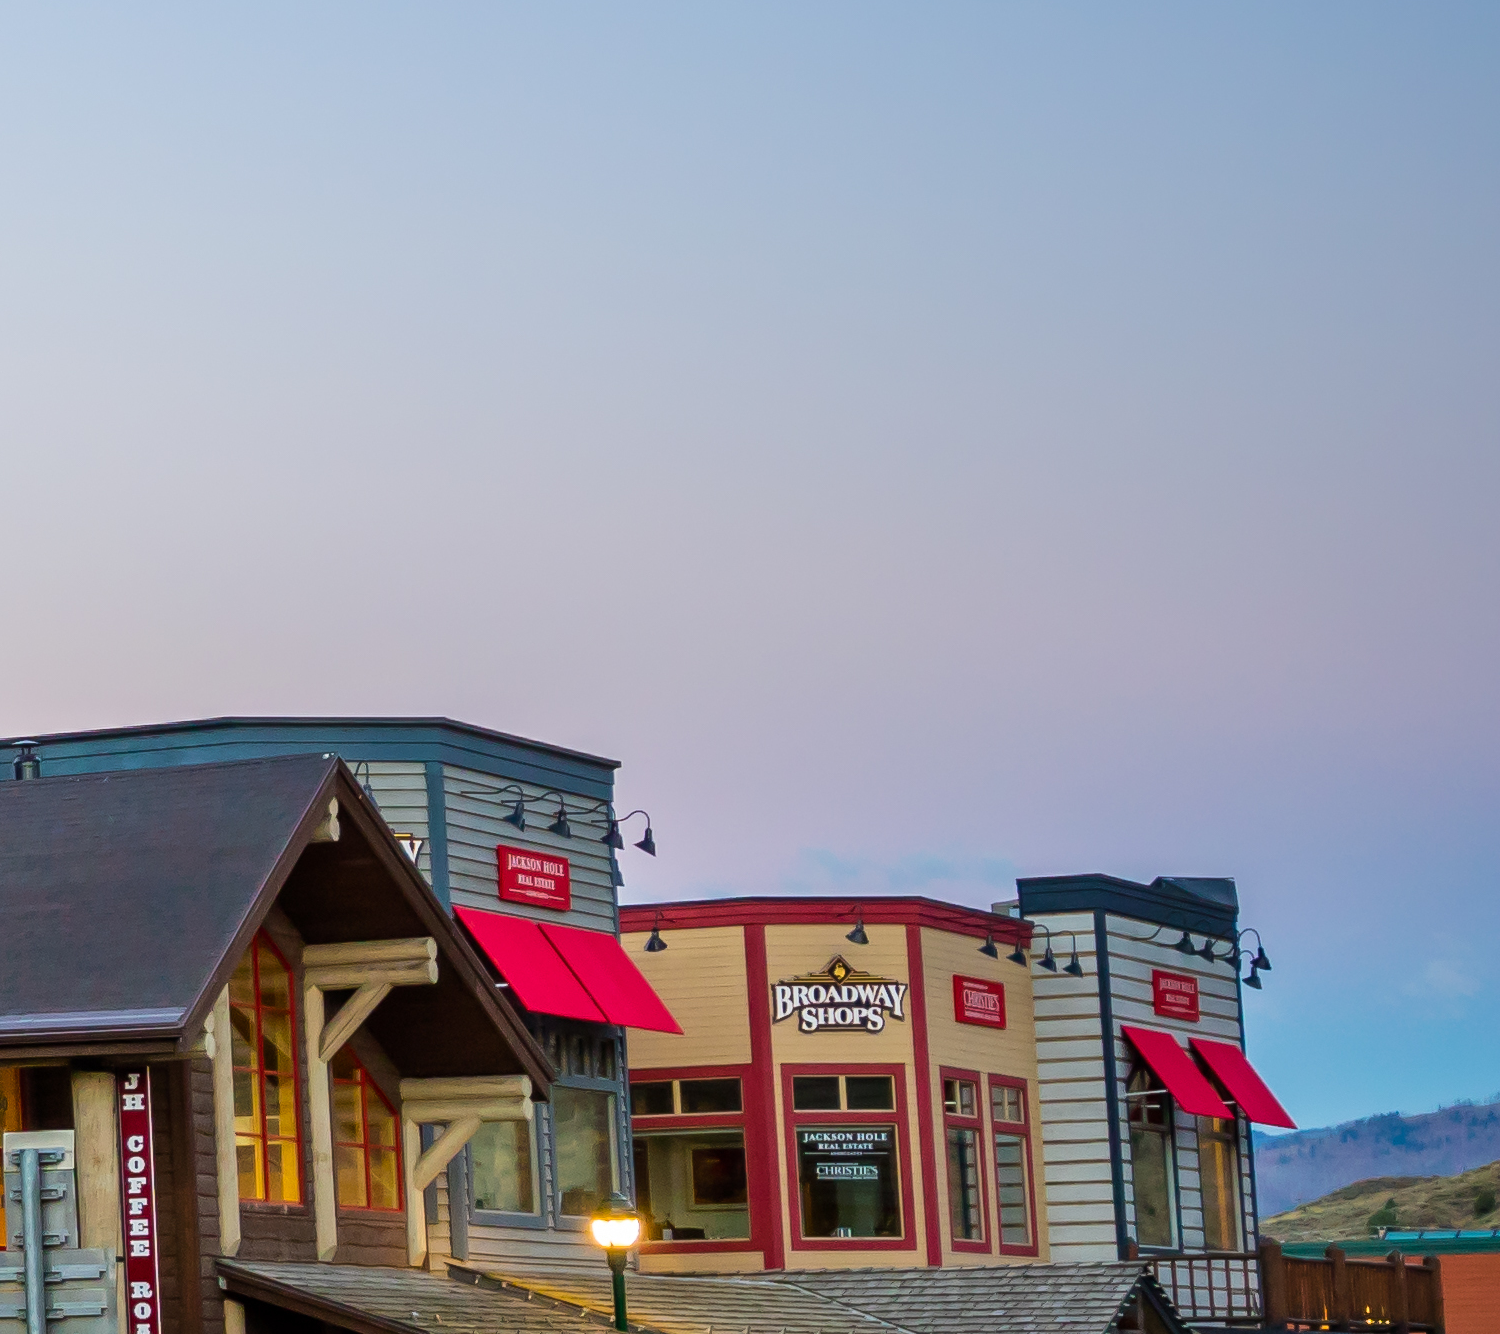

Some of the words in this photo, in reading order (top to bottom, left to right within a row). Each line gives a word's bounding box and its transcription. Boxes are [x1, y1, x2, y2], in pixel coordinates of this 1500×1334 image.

[507, 853, 542, 872] JACKSON
[543, 860, 565, 877] HOLE
[775, 984, 906, 1020] BROADWAY
[801, 1006, 884, 1031] SHOPS
[803, 1132, 853, 1143] JACKSON
[856, 1132, 888, 1141] HOLE
[127, 1135, 151, 1257] COFFEE
